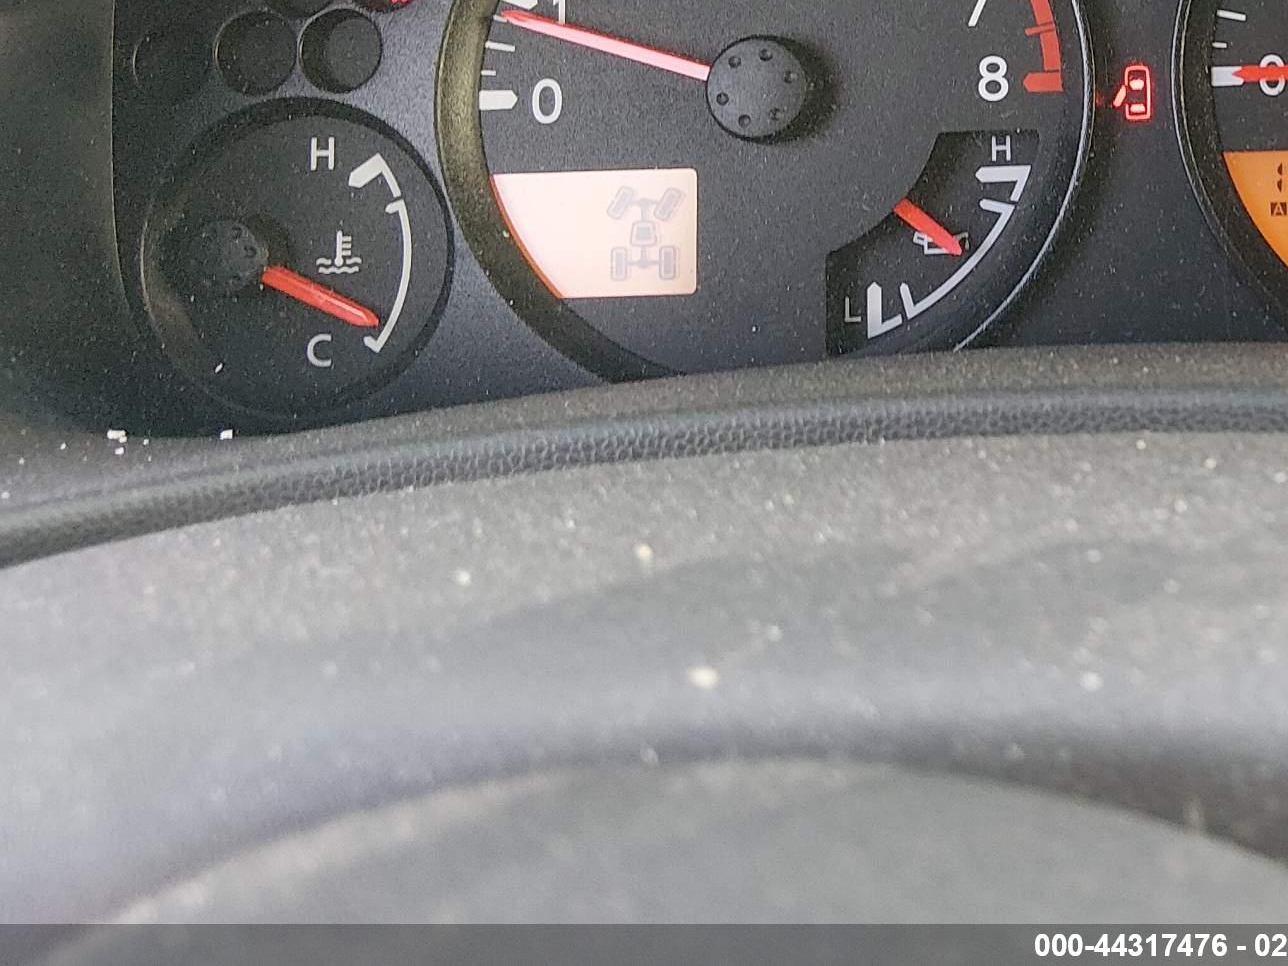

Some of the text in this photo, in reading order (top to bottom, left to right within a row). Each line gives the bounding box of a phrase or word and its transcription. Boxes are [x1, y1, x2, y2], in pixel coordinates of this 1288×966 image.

[977, 56, 1009, 102] 8
[532, 78, 563, 124] 0
[310, 136, 335, 172] H
[991, 137, 1012, 161] H
[845, 297, 861, 323] L
[306, 335, 332, 368] C
